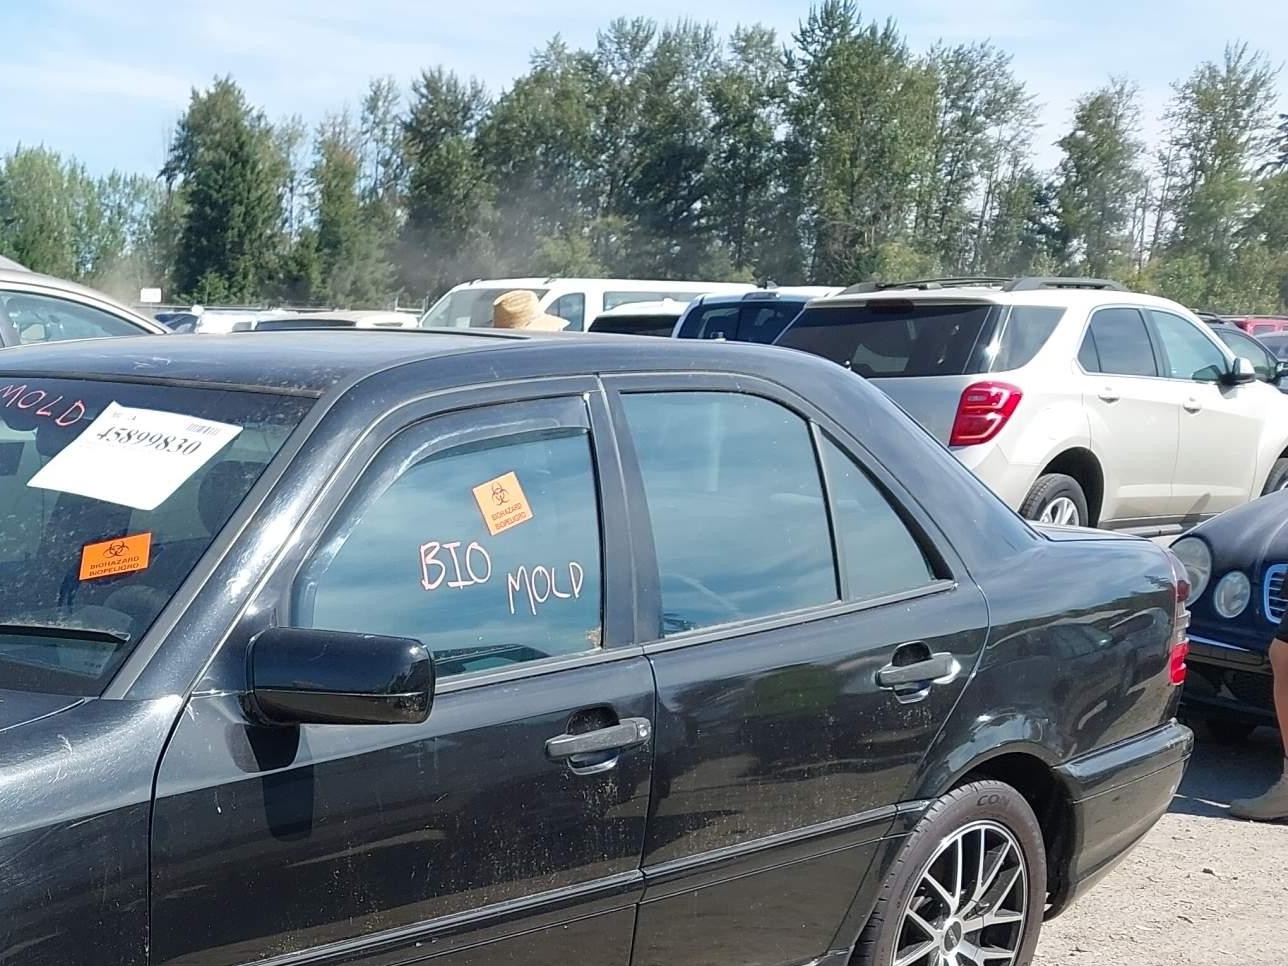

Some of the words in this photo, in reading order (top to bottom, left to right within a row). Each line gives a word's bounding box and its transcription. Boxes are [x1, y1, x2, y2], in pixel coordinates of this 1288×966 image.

[97, 426, 202, 456] 45899830
[89, 555, 140, 570] BIOHAZARD
[419, 541, 492, 590] BIO
[507, 561, 584, 615] MOLD
